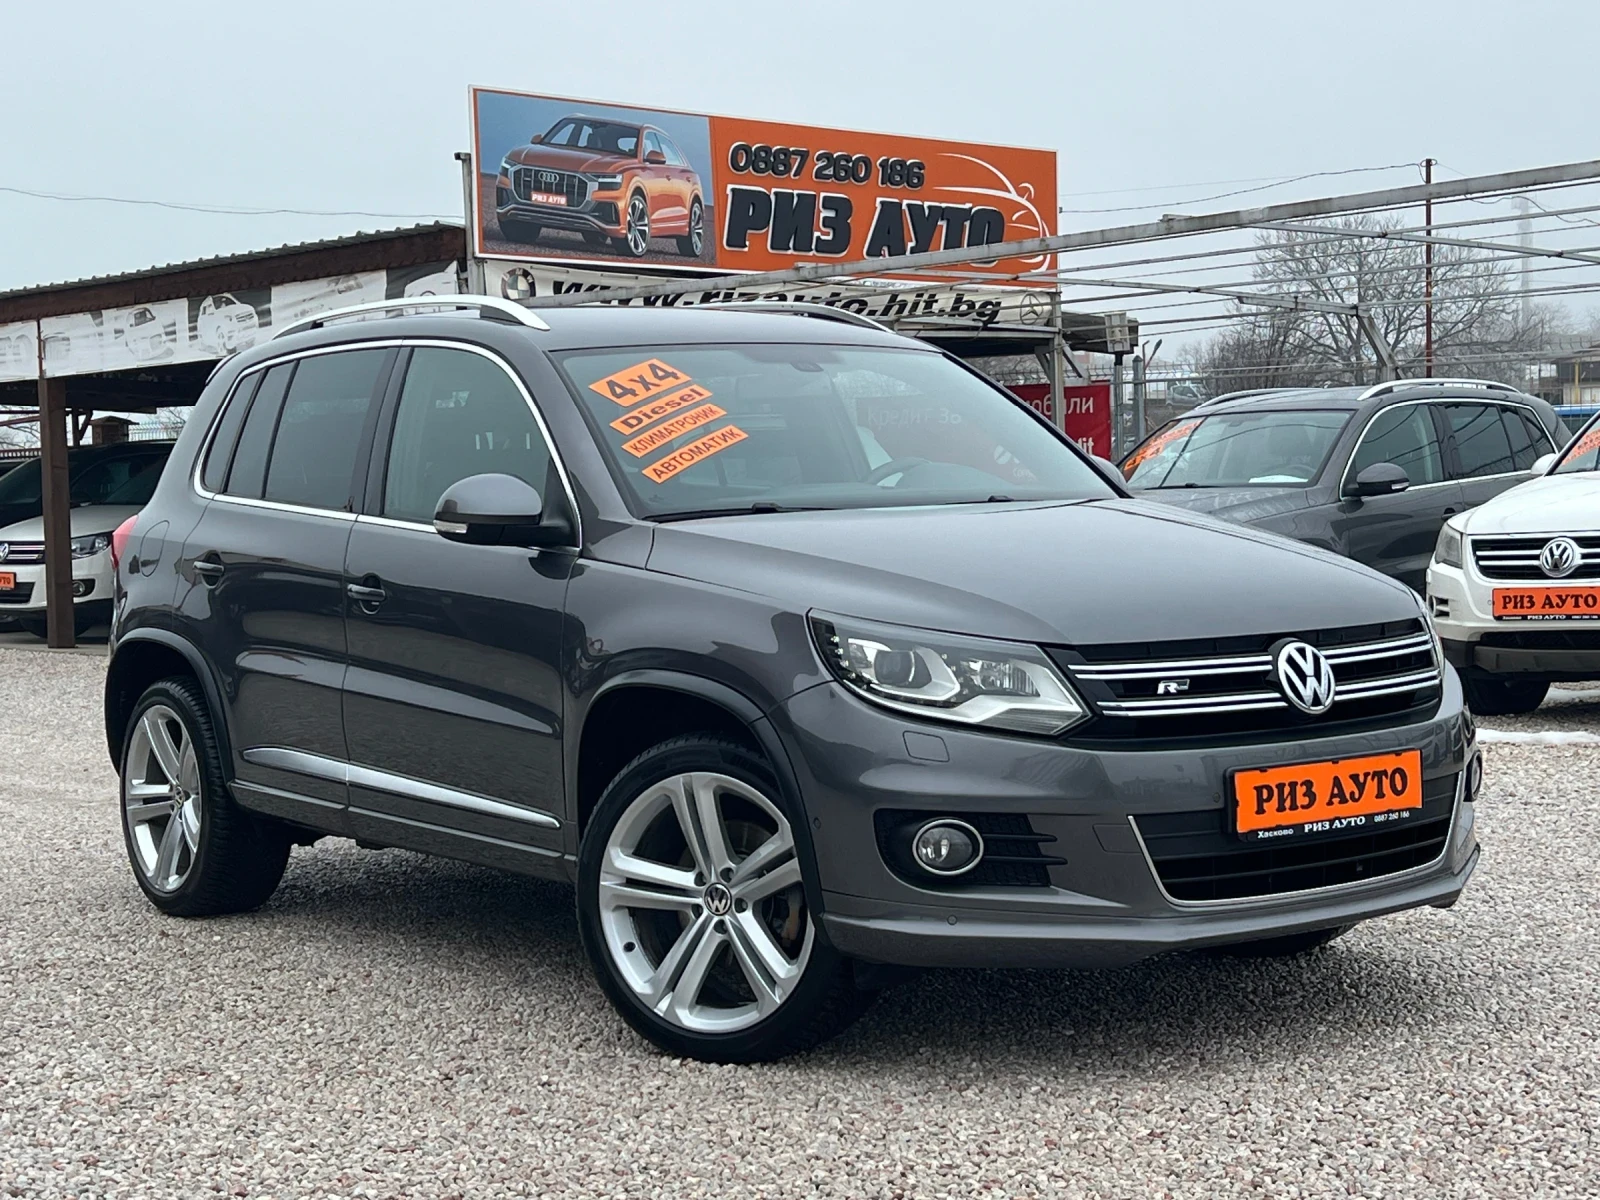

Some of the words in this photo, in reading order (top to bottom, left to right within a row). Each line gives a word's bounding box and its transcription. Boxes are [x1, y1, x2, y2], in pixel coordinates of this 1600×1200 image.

[729, 142, 809, 179] 0887
[812, 150, 873, 186] 260
[876, 156, 925, 190] 186
[723, 184, 854, 257] РИЗ
[863, 196, 1005, 267] АУТО
[620, 387, 705, 429] Diesel
[630, 405, 720, 453] КЛИМАТРОНИК
[652, 428, 741, 479] АВТОМАТИК
[1501, 594, 1536, 609] РИЗ
[1541, 593, 1598, 609] АУТО
[1253, 779, 1317, 815] РИЗ
[1325, 767, 1408, 806] АУТО
[1257, 827, 1294, 839] Хасково
[1304, 820, 1330, 833] РИЗ
[1331, 815, 1366, 830] АУТО
